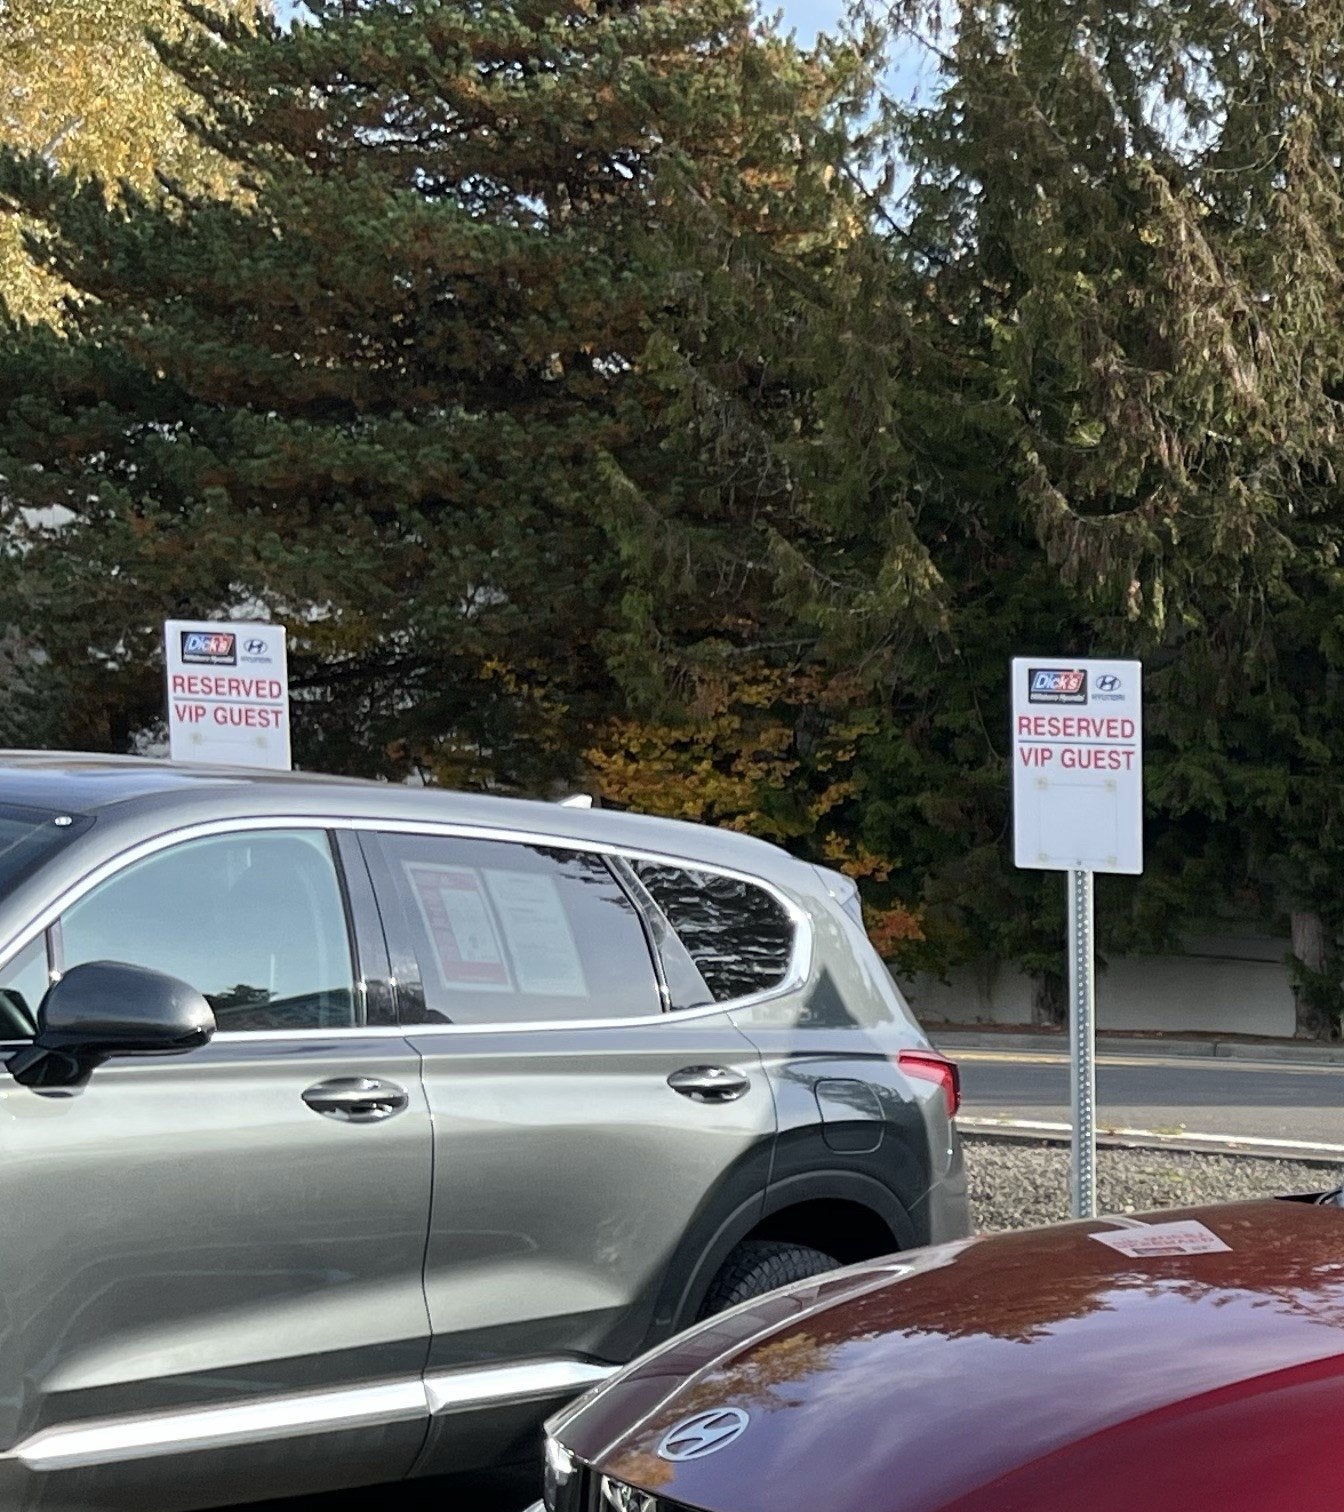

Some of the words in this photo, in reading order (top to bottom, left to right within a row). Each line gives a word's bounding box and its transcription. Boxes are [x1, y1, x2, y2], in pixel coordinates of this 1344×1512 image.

[172, 675, 282, 699] RESERVED
[175, 704, 206, 723] VIP
[213, 706, 283, 729] GUEST
[1018, 716, 1135, 739] RESERVED
[1020, 747, 1053, 767] VIP
[1060, 748, 1136, 770] GUEST
